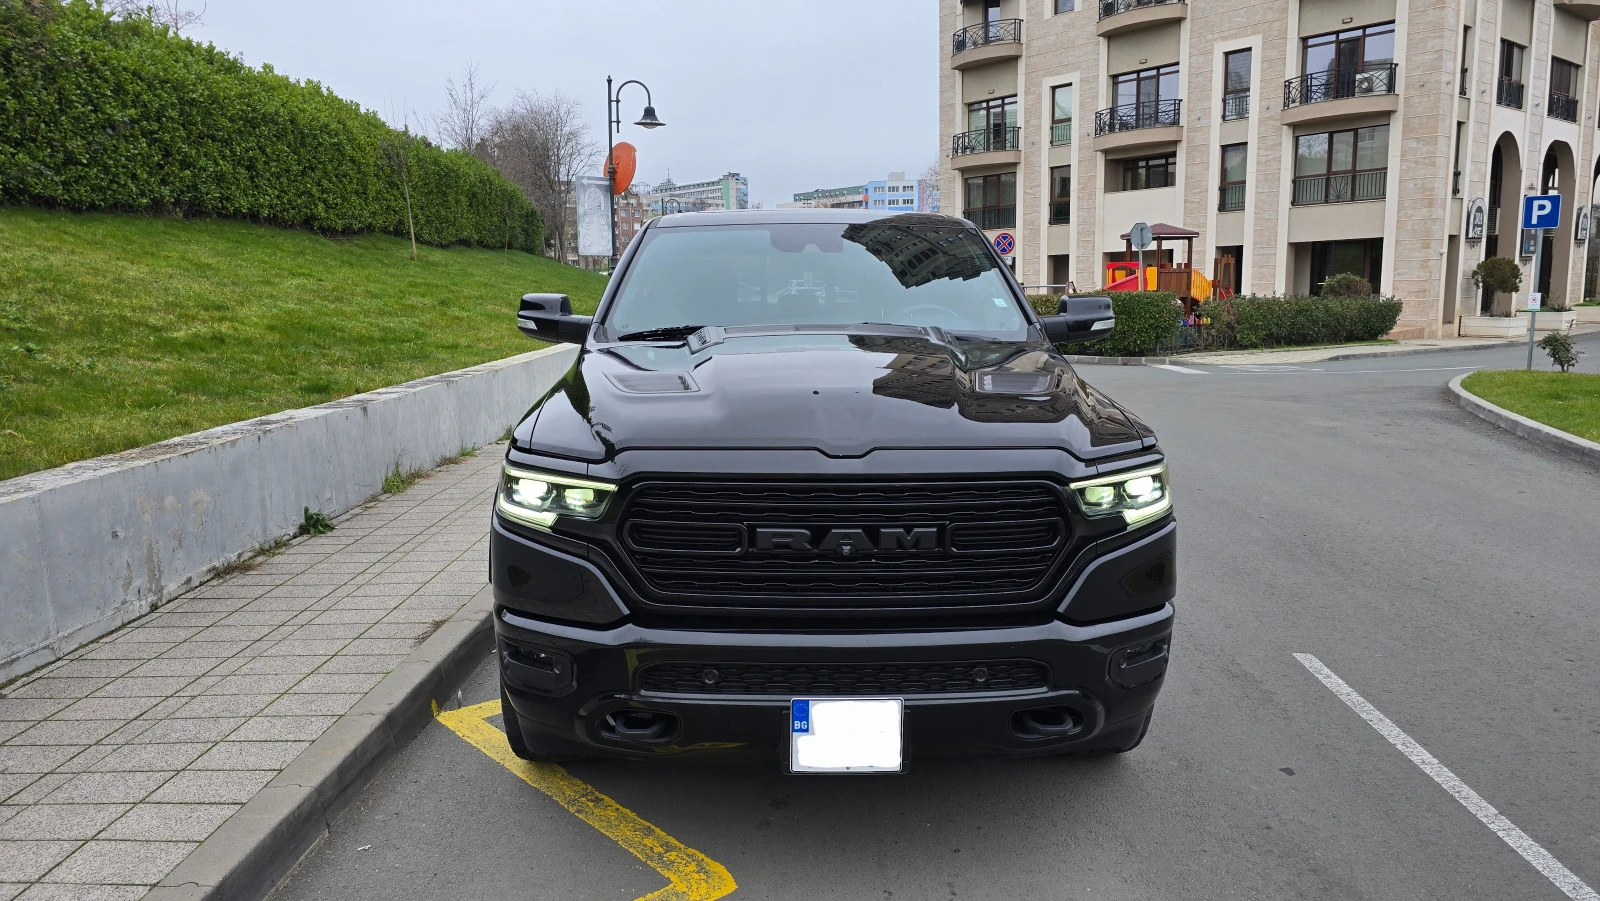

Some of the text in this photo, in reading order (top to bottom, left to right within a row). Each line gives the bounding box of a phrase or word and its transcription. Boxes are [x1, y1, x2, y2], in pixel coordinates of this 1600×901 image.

[1531, 200, 1551, 224] P
[756, 528, 937, 551] RAM
[794, 721, 808, 730] BG
